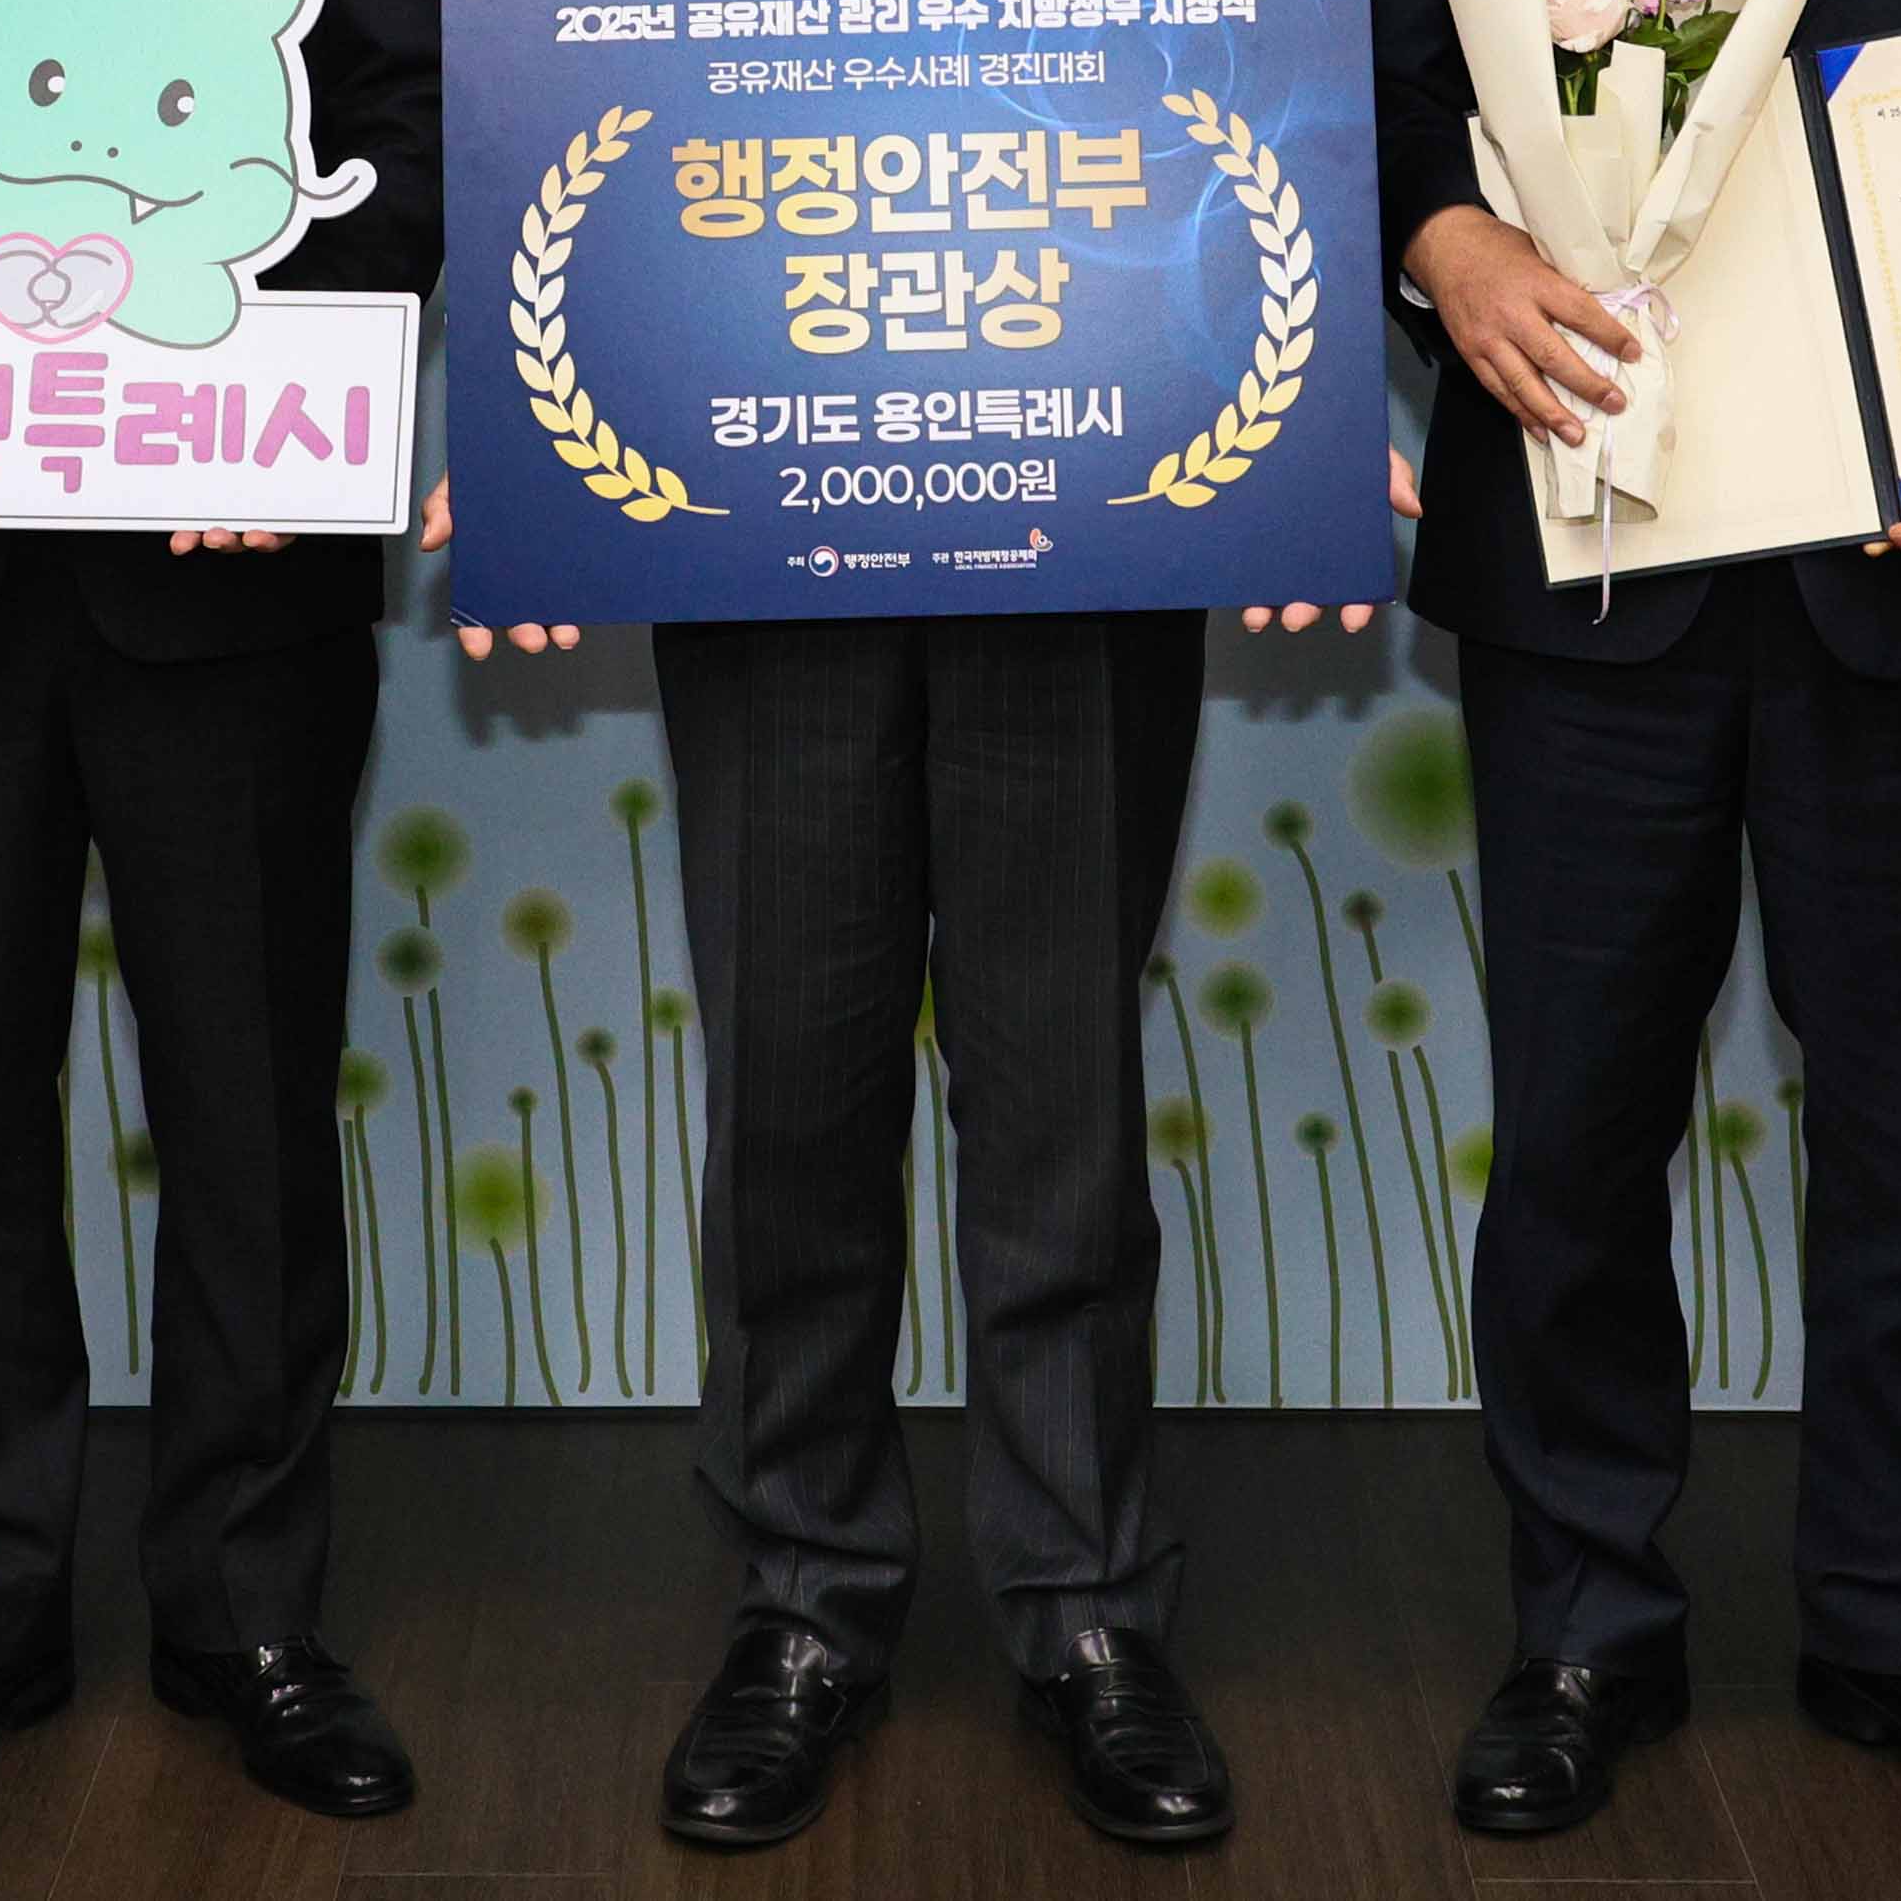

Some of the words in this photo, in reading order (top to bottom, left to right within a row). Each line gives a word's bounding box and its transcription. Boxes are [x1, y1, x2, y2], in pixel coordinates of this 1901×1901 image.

[555, 4, 675, 42] 2025년
[687, 0, 831, 39] 공유재산
[707, 59, 835, 94] 공유재산
[843, 54, 970, 90] 우수사례
[979, 50, 1106, 86] 경진대회
[672, 129, 1148, 239] 행정안전부
[785, 248, 1070, 355] 장관상
[709, 393, 861, 447] 경기도
[873, 387, 1123, 442] 용인특례시
[780, 457, 1058, 512] 2,000,000원
[843, 551, 911, 569] 행정안전부
